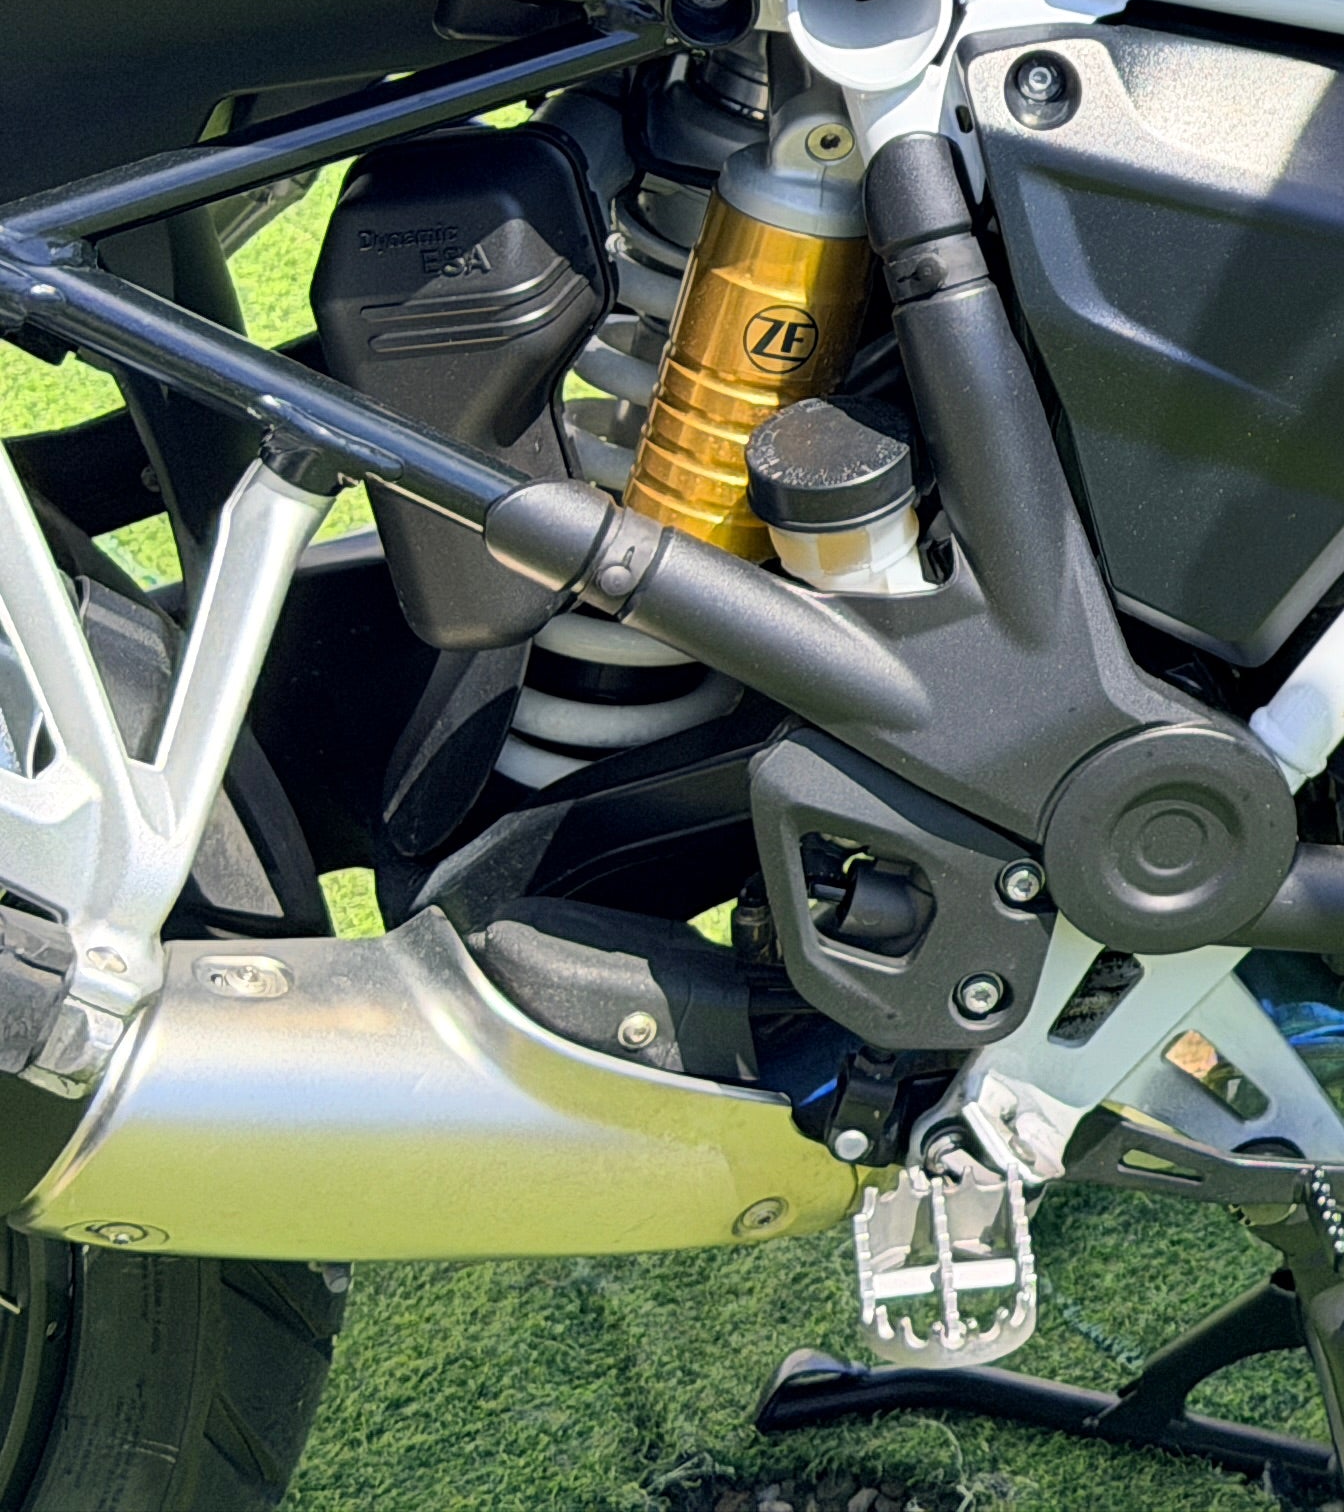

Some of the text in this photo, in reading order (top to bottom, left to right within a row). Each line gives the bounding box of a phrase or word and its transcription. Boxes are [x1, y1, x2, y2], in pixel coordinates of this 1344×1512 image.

[358, 222, 459, 257] Dynamic
[420, 243, 492, 278] ESA
[748, 313, 818, 364] ZF
